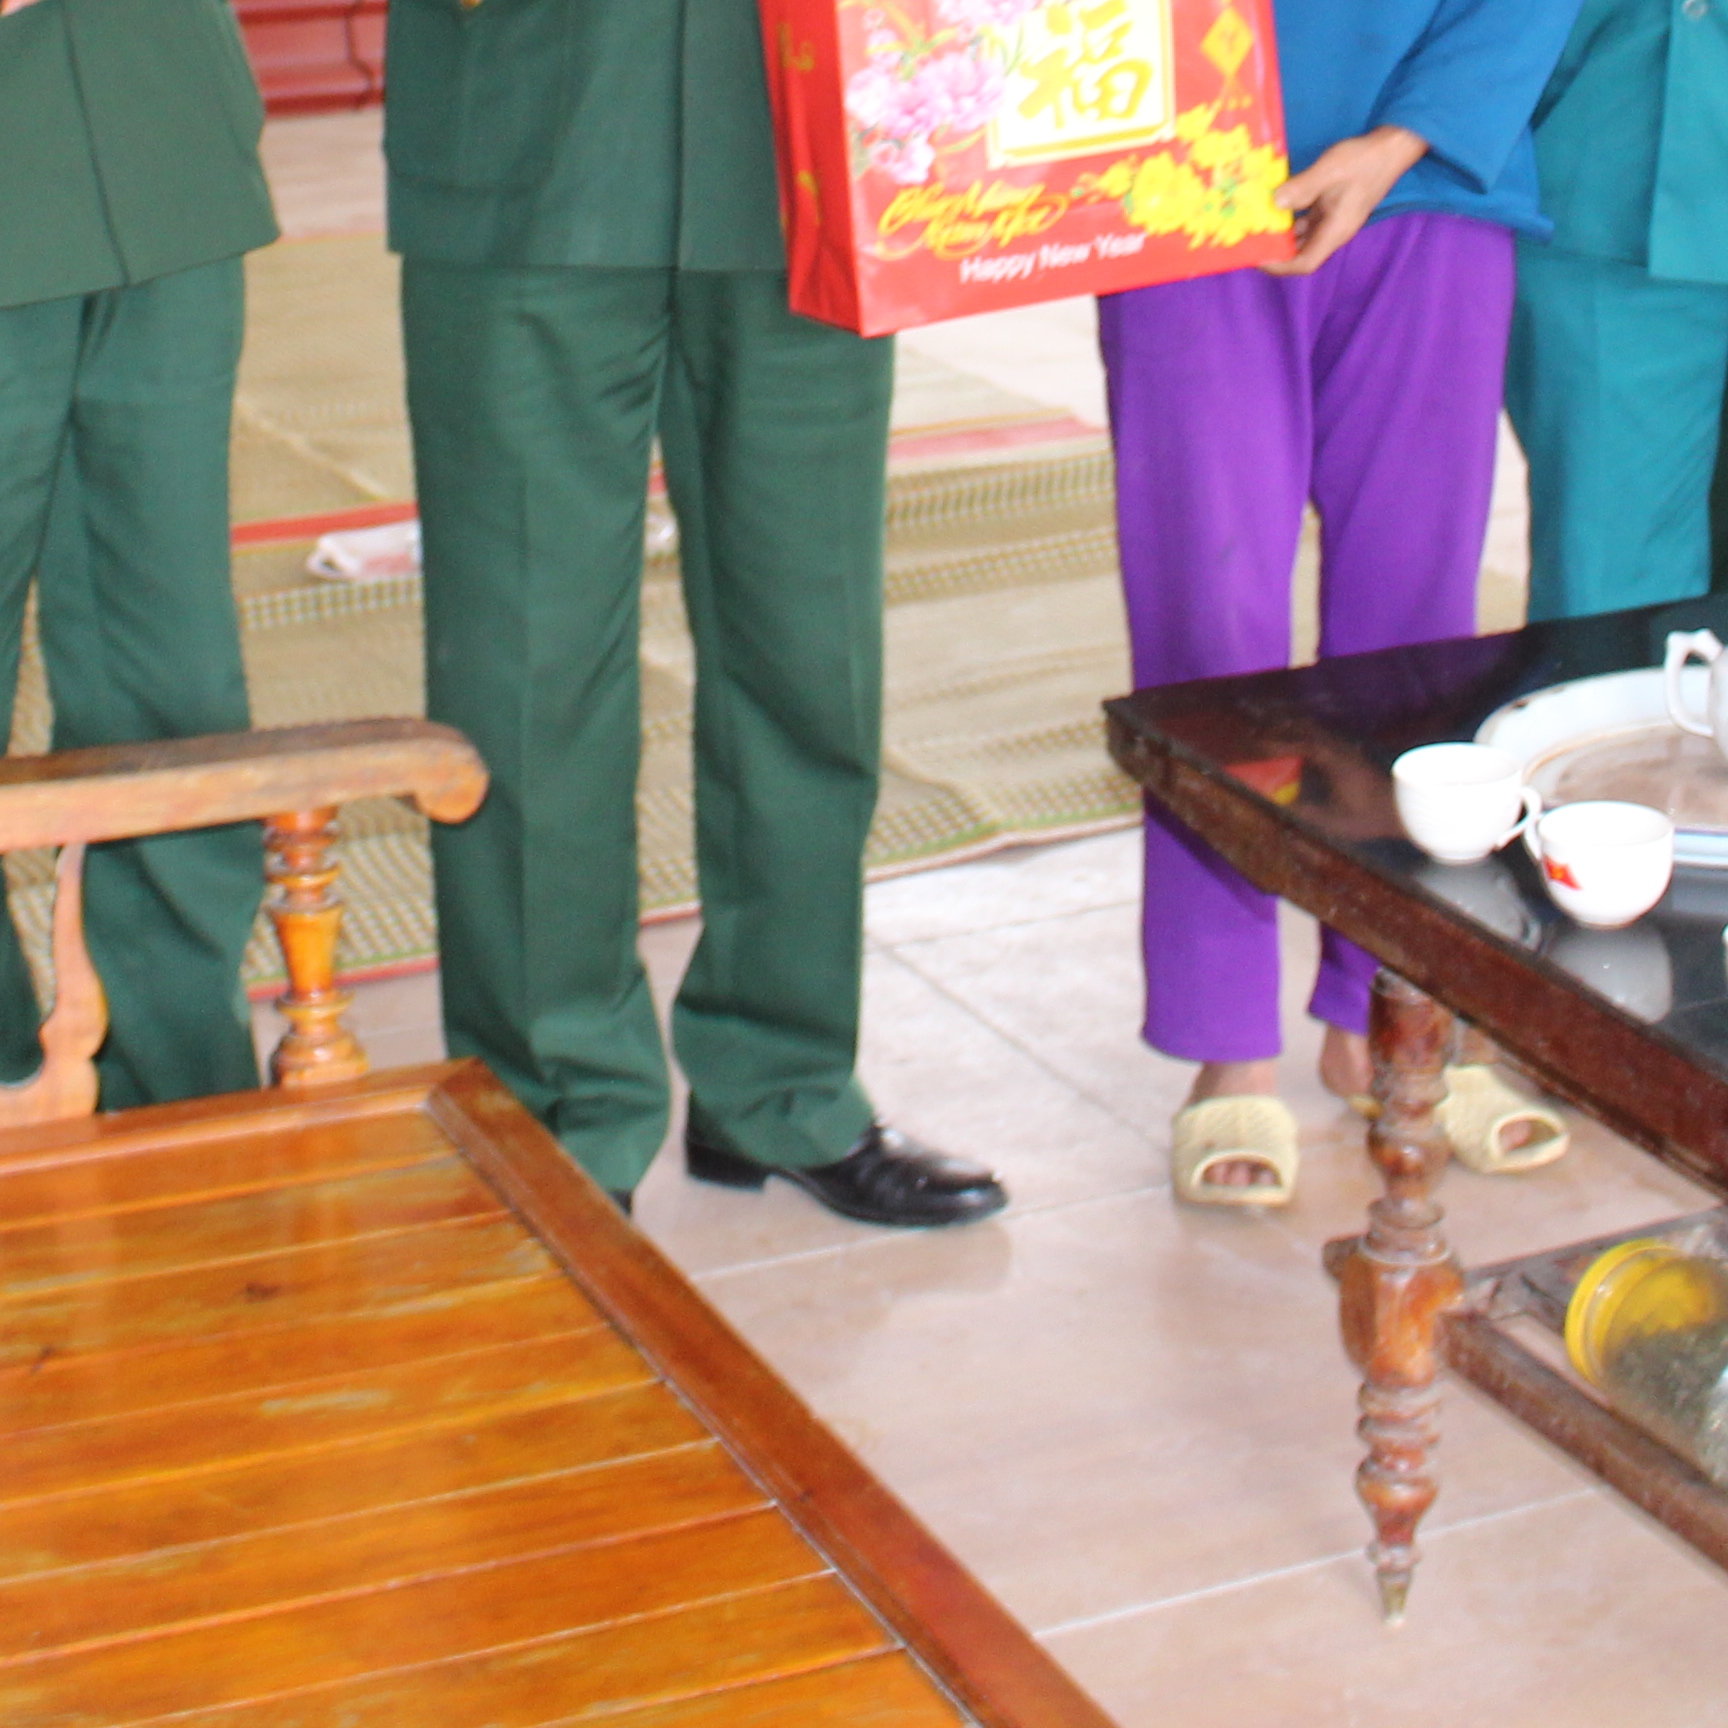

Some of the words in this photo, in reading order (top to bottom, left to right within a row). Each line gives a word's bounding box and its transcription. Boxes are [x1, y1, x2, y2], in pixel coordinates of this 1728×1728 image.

[959, 252, 1036, 284] Happy
[1038, 242, 1092, 270] New
[1095, 232, 1146, 259] Year
